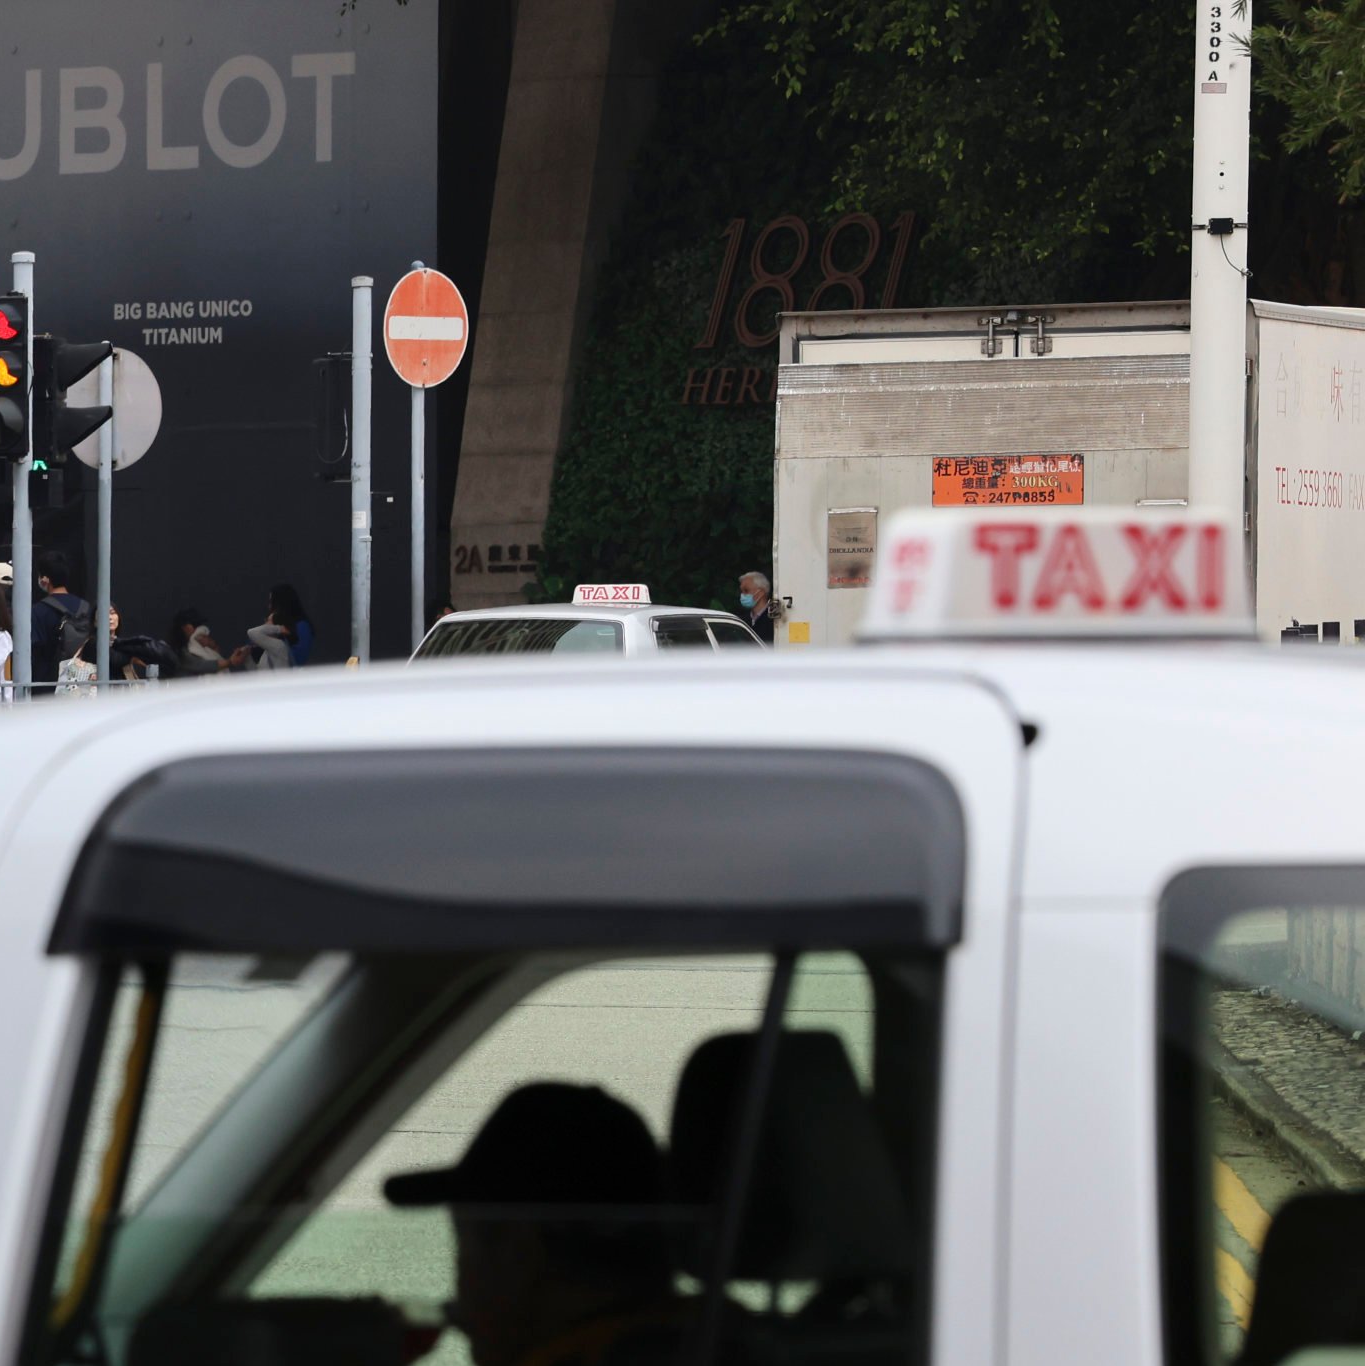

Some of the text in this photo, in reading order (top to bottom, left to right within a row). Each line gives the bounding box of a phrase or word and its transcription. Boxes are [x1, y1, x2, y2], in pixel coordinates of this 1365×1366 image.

[693, 211, 916, 348] 1881
[113, 299, 253, 322] BIG BANG UNICO
[142, 326, 224, 346] TITANIUM
[454, 544, 484, 574] 2A
[972, 521, 1226, 615] TAXI
[580, 586, 640, 600] TAXI
